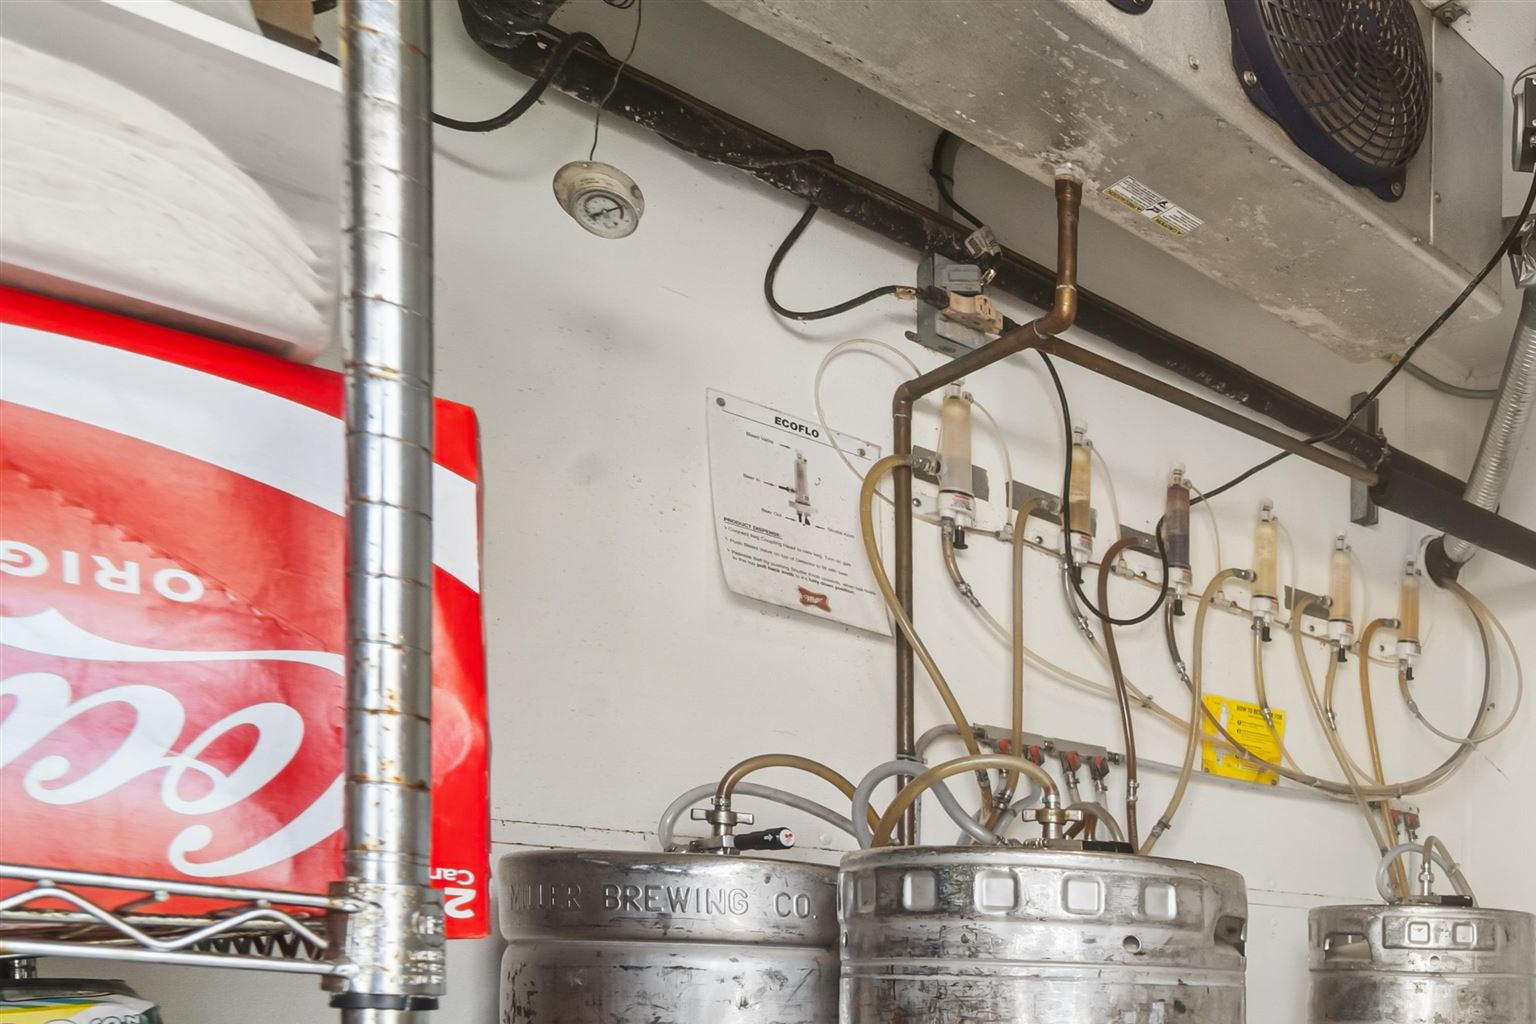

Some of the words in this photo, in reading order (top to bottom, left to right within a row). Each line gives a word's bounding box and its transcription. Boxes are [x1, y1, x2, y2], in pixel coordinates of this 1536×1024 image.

[774, 416, 820, 438] ECOFLO
[0, 540, 204, 603] ORIG
[510, 884, 582, 912] MILLER
[604, 885, 749, 915] BREWING
[772, 890, 819, 920] CO.
